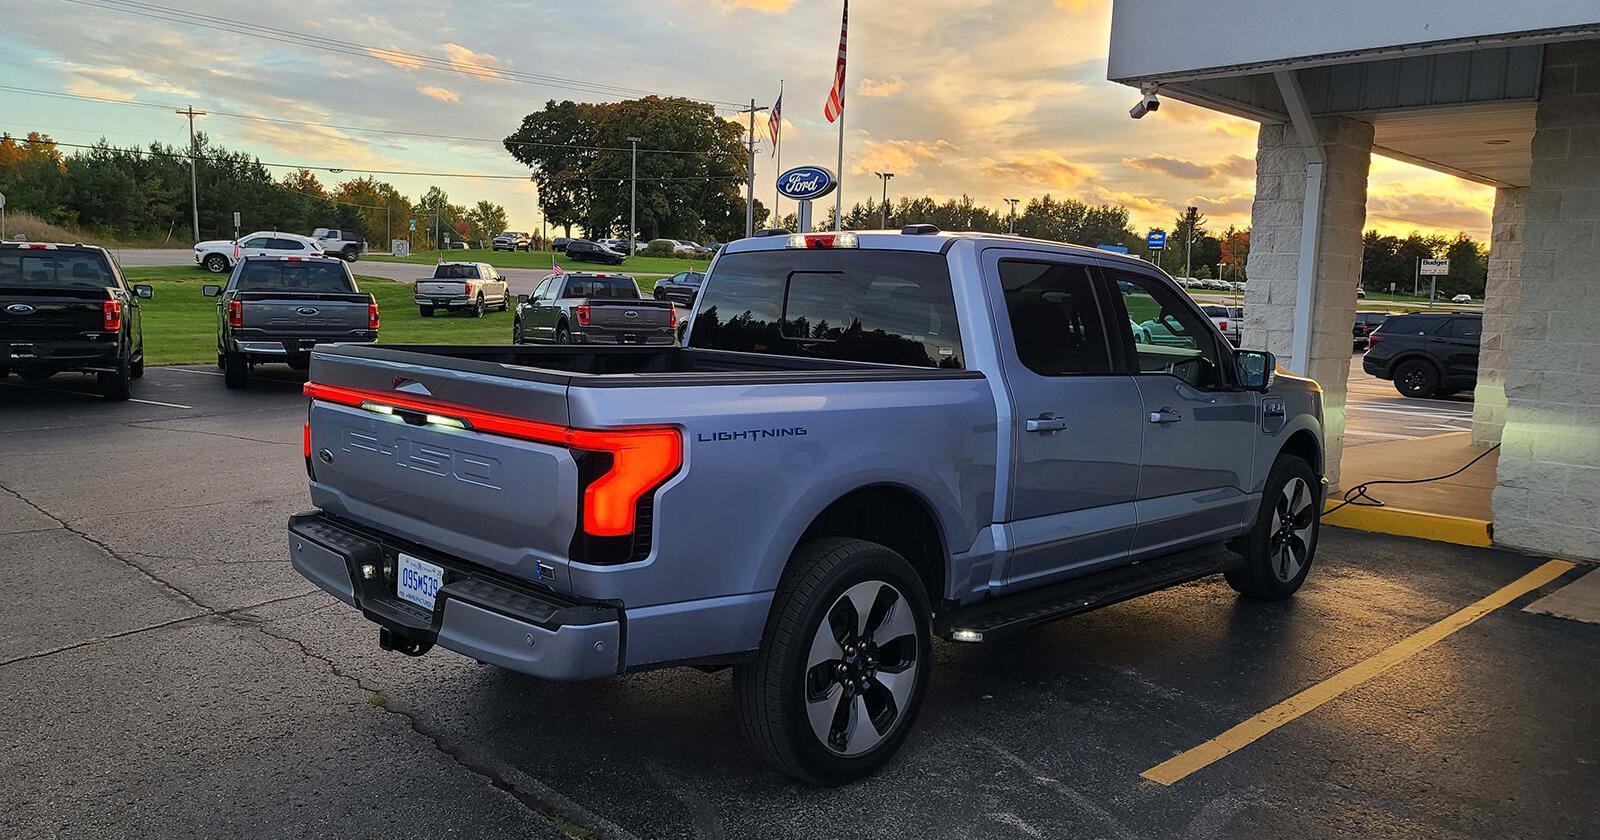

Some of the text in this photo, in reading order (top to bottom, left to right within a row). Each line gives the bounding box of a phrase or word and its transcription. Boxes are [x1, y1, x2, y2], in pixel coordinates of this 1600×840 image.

[785, 172, 819, 193] Ford
[697, 427, 808, 442] LIGHTNING
[341, 426, 503, 490] F-150
[403, 567, 438, 598] 095M539
